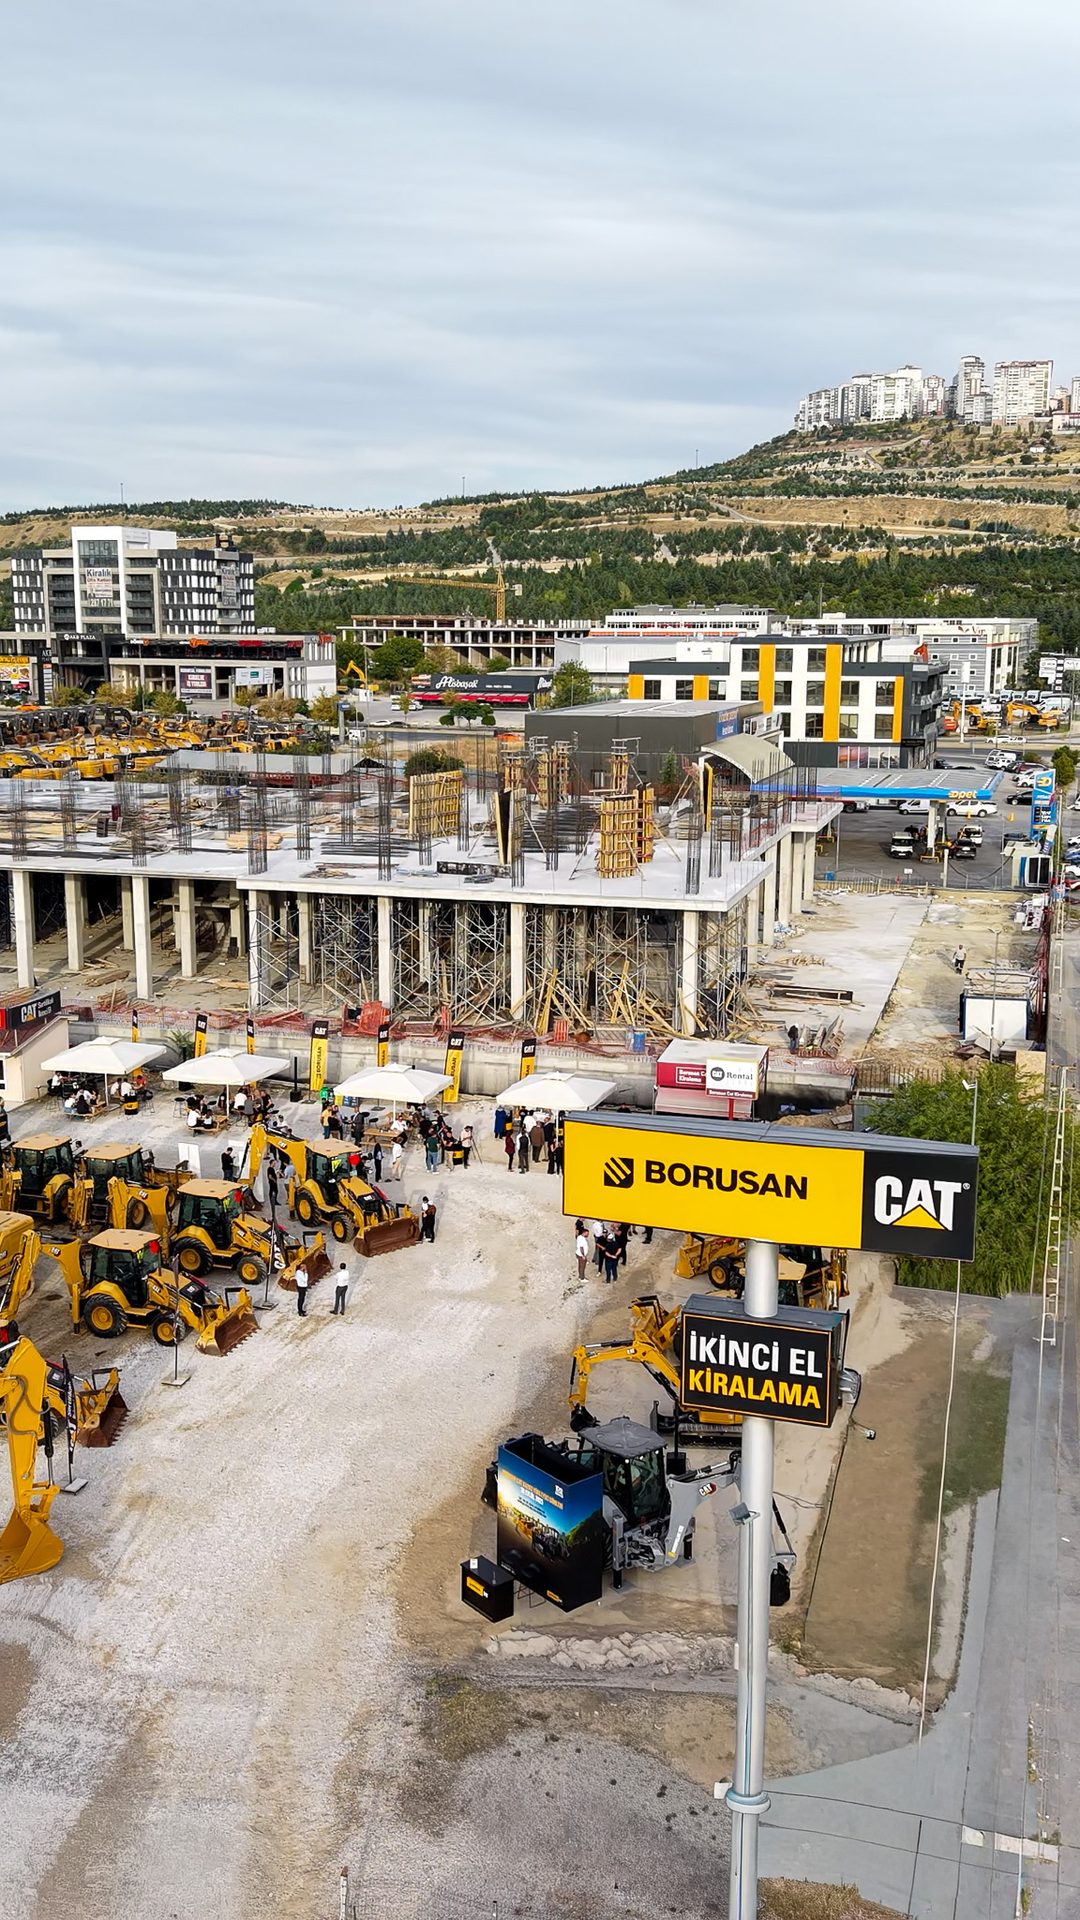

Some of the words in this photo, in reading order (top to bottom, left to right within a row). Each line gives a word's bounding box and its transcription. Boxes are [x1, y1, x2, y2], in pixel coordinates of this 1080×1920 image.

[21, 1003, 37, 1023] CAT
[314, 1027, 327, 1035] CAT
[450, 1038, 463, 1046] CAT
[524, 1045, 535, 1054] CAT
[726, 1071, 753, 1081] Rental
[645, 1160, 808, 1200] BORUSAN
[874, 1175, 962, 1231] CAT
[690, 1330, 780, 1372] İKİNCİ
[789, 1348, 823, 1379] EL
[689, 1367, 821, 1409] KİRALAMA
[700, 1483, 713, 1497] CAT
